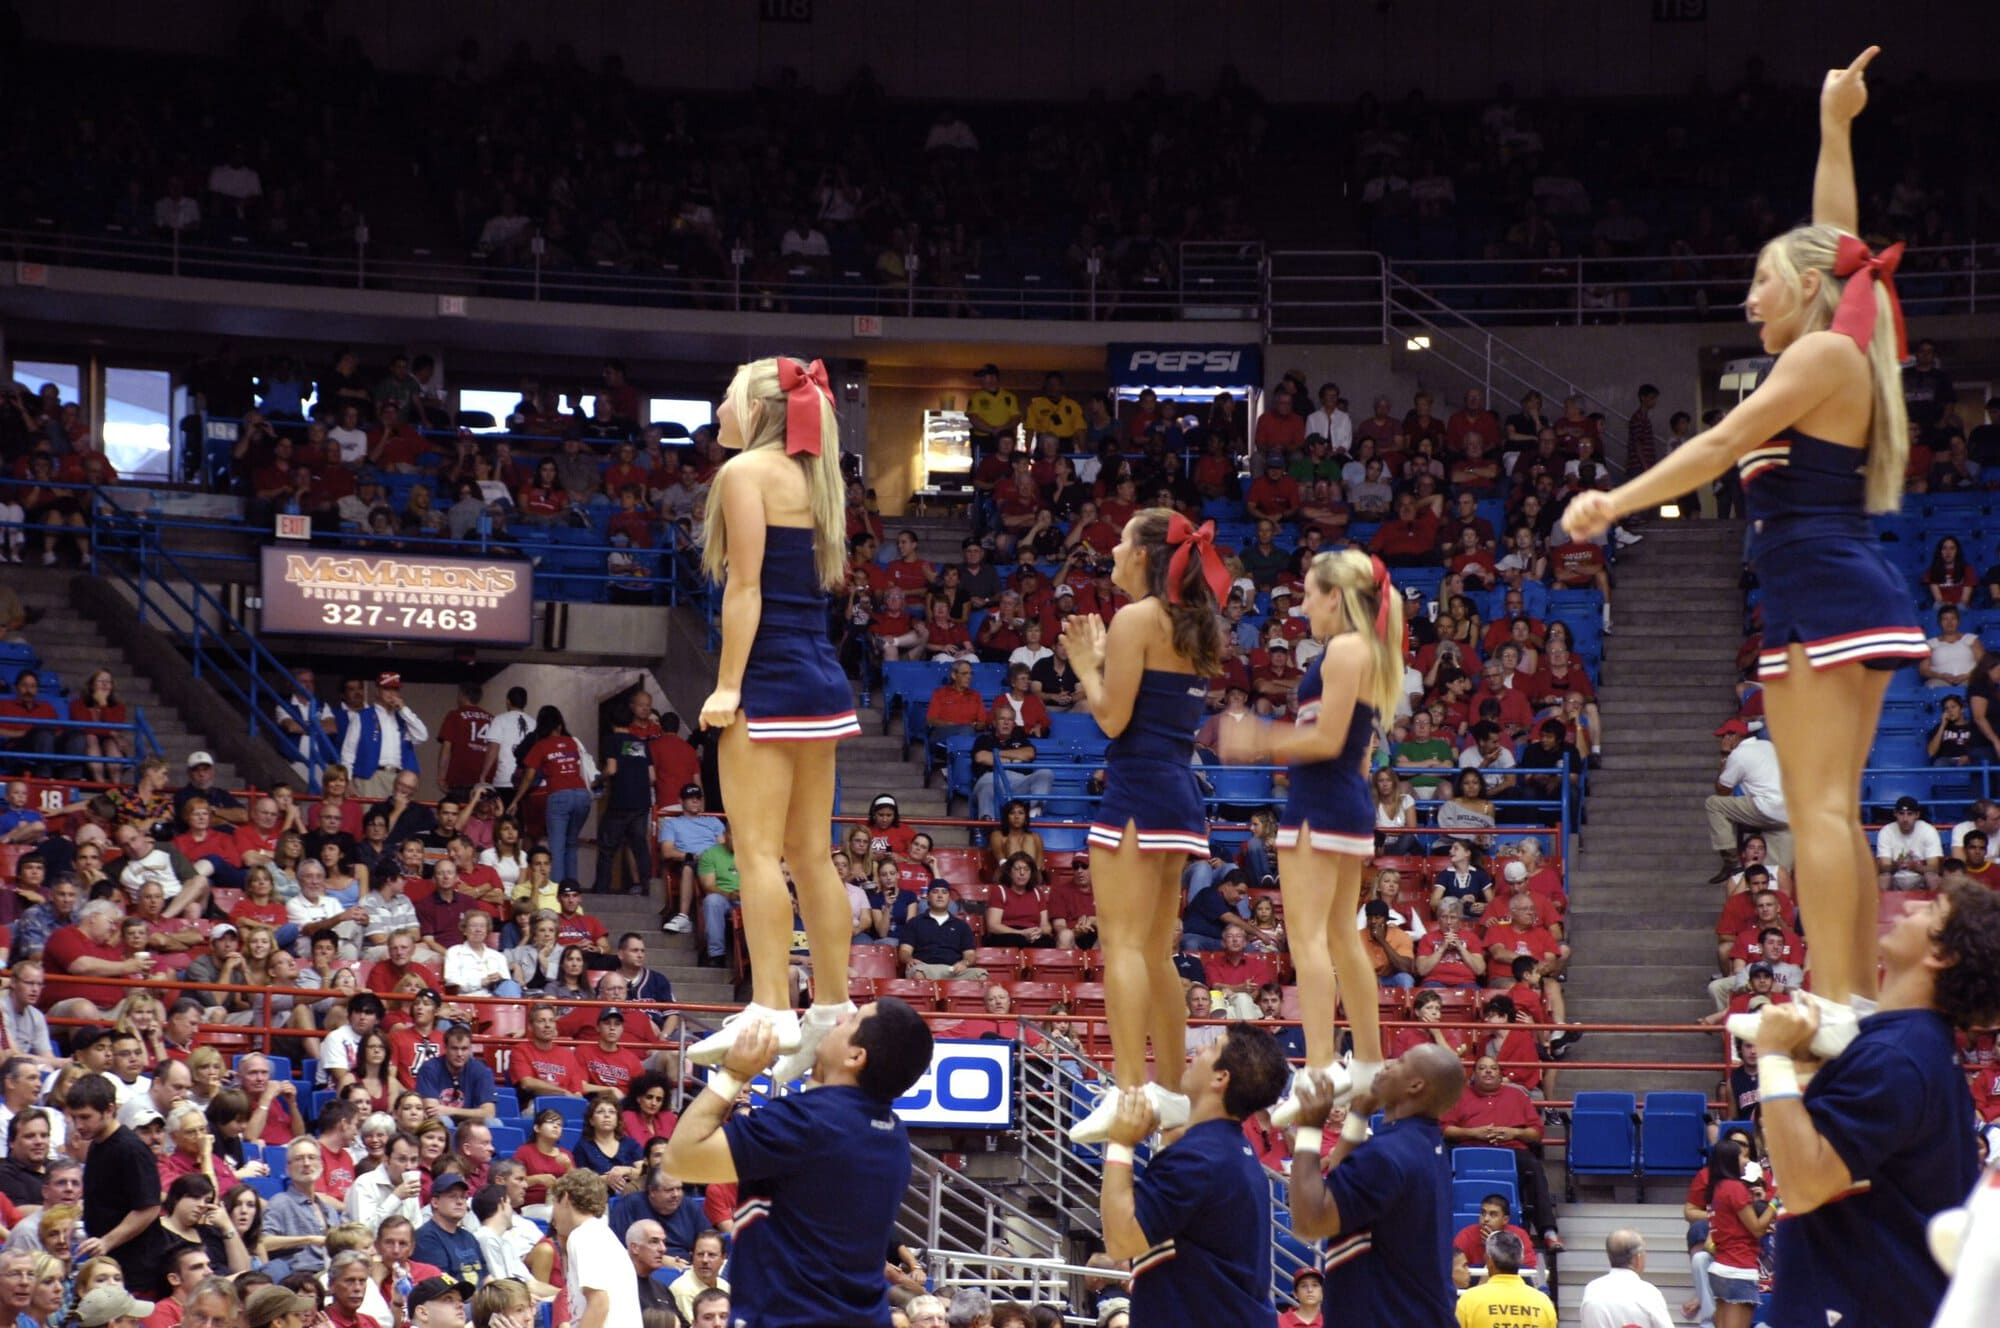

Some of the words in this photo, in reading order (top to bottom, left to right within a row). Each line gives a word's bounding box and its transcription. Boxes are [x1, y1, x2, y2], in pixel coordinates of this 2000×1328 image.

[1129, 350, 1241, 372] PEPSI
[280, 517, 306, 535] EXIT
[303, 587, 361, 601] PRIME
[373, 592, 499, 608] STEAKHOUSE
[322, 603, 478, 631] 327-7463
[471, 721, 489, 742] 14
[40, 790, 63, 809] 18
[1487, 1304, 1541, 1317] EVENT
